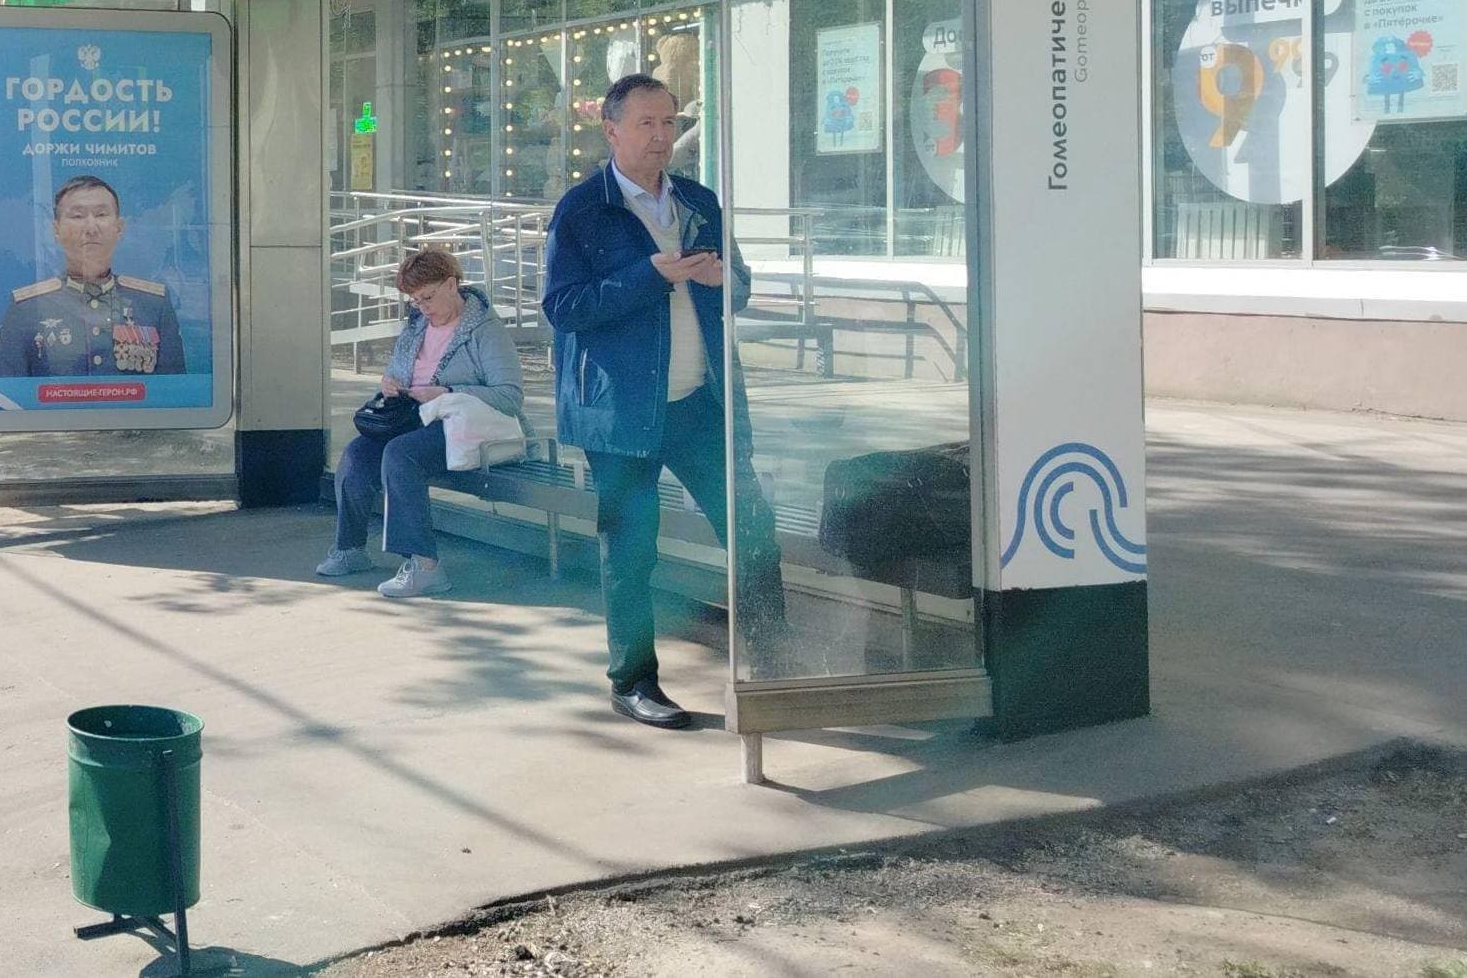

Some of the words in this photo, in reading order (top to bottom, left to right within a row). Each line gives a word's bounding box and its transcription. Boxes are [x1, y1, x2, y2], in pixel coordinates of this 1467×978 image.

[6, 77, 173, 104] ГОРДОСТЬ
[18, 108, 160, 133] РОССИИ!
[22, 143, 80, 156] ДОРЖИ
[85, 144, 157, 155] ЧИМИТОВ
